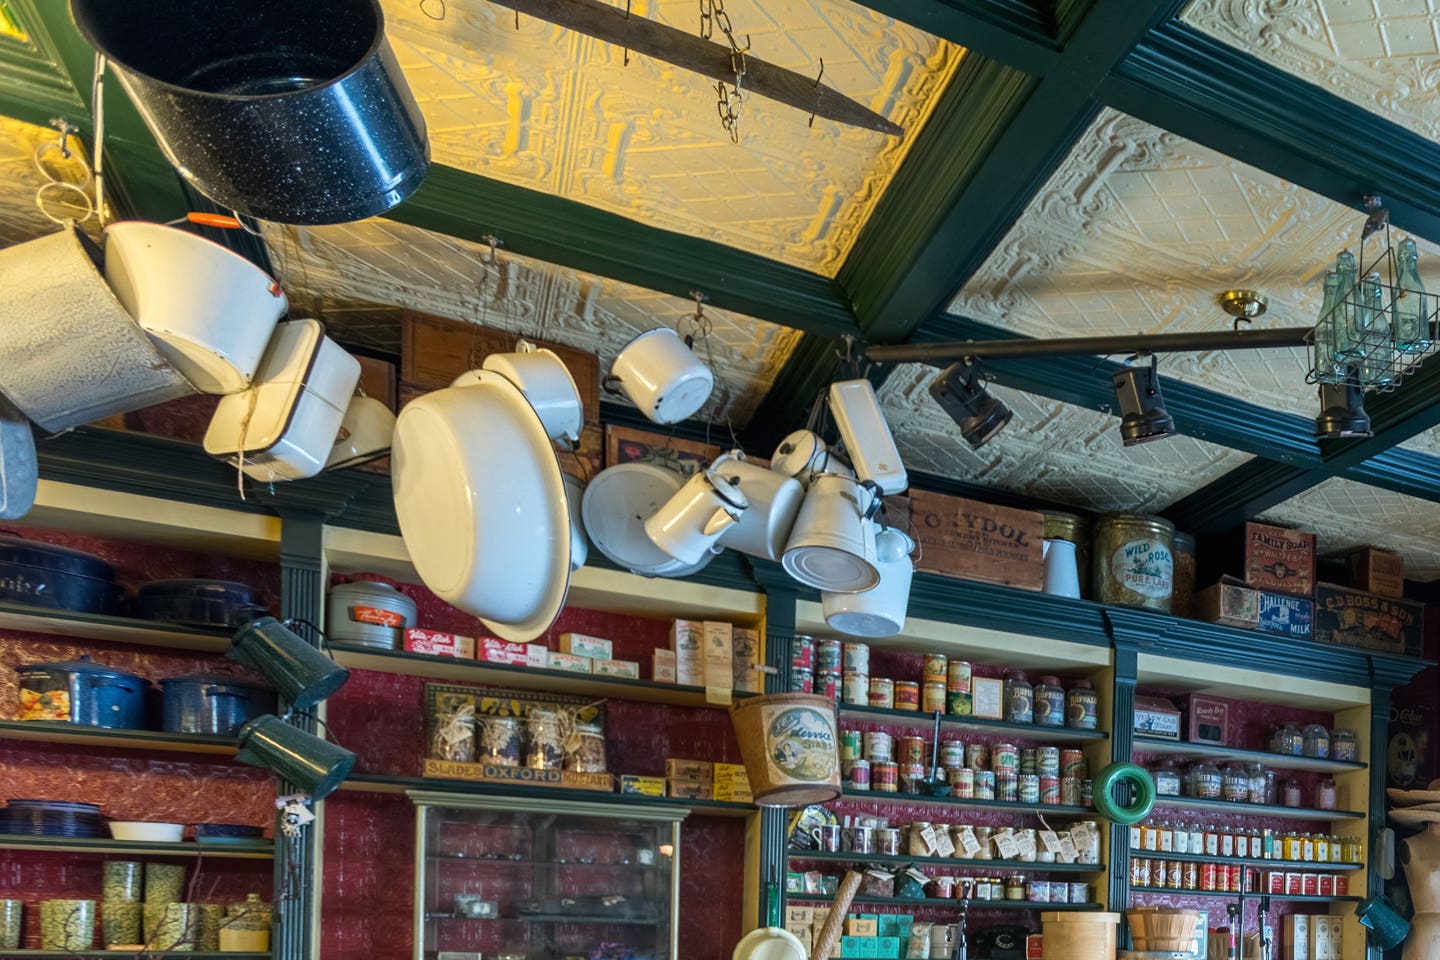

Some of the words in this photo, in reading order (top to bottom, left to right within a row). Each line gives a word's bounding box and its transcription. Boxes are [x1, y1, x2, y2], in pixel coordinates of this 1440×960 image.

[925, 513, 1029, 548] OYDOL
[1252, 531, 1284, 549] FAMILY
[1286, 540, 1309, 550] SOAP
[1125, 543, 1150, 558] WILD
[1148, 551, 1170, 563] ROSE
[1125, 573, 1151, 584] PURE
[1152, 576, 1169, 589] LARD
[1259, 593, 1301, 614] CHALLENGE
[1345, 595, 1378, 609] BOSS
[1380, 602, 1389, 612] &
[1391, 605, 1415, 625] SON
[1290, 623, 1310, 635] MILK
[426, 761, 482, 777] SLADES
[485, 766, 561, 782] OXFORD
[563, 772, 610, 786] MUSTARD
